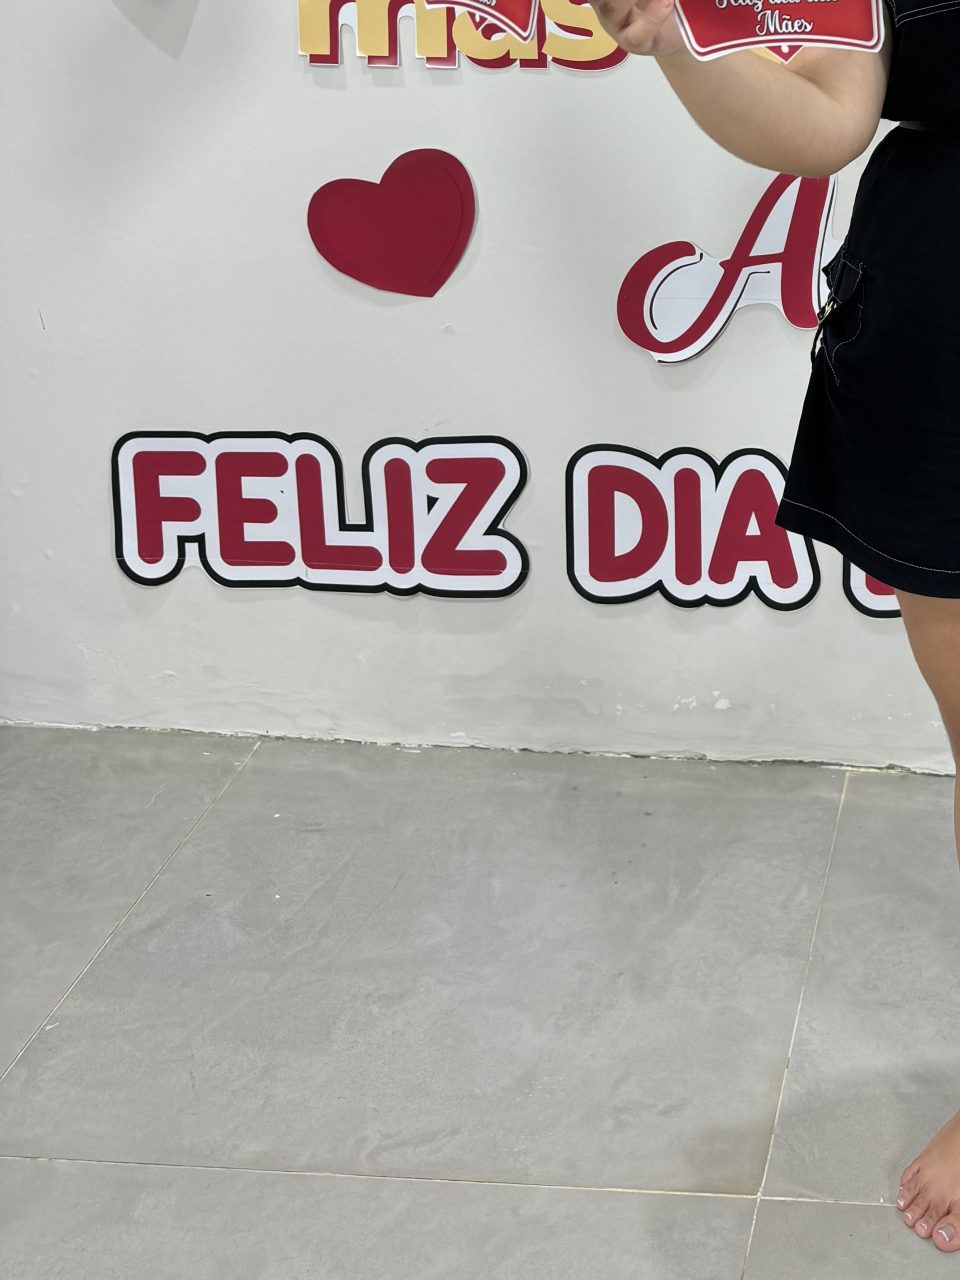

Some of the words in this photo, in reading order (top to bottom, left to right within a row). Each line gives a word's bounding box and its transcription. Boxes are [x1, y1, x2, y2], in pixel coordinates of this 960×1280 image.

[755, 9, 813, 36] Mães
[120, 440, 518, 587] FELIZ
[577, 453, 810, 600] DIA
